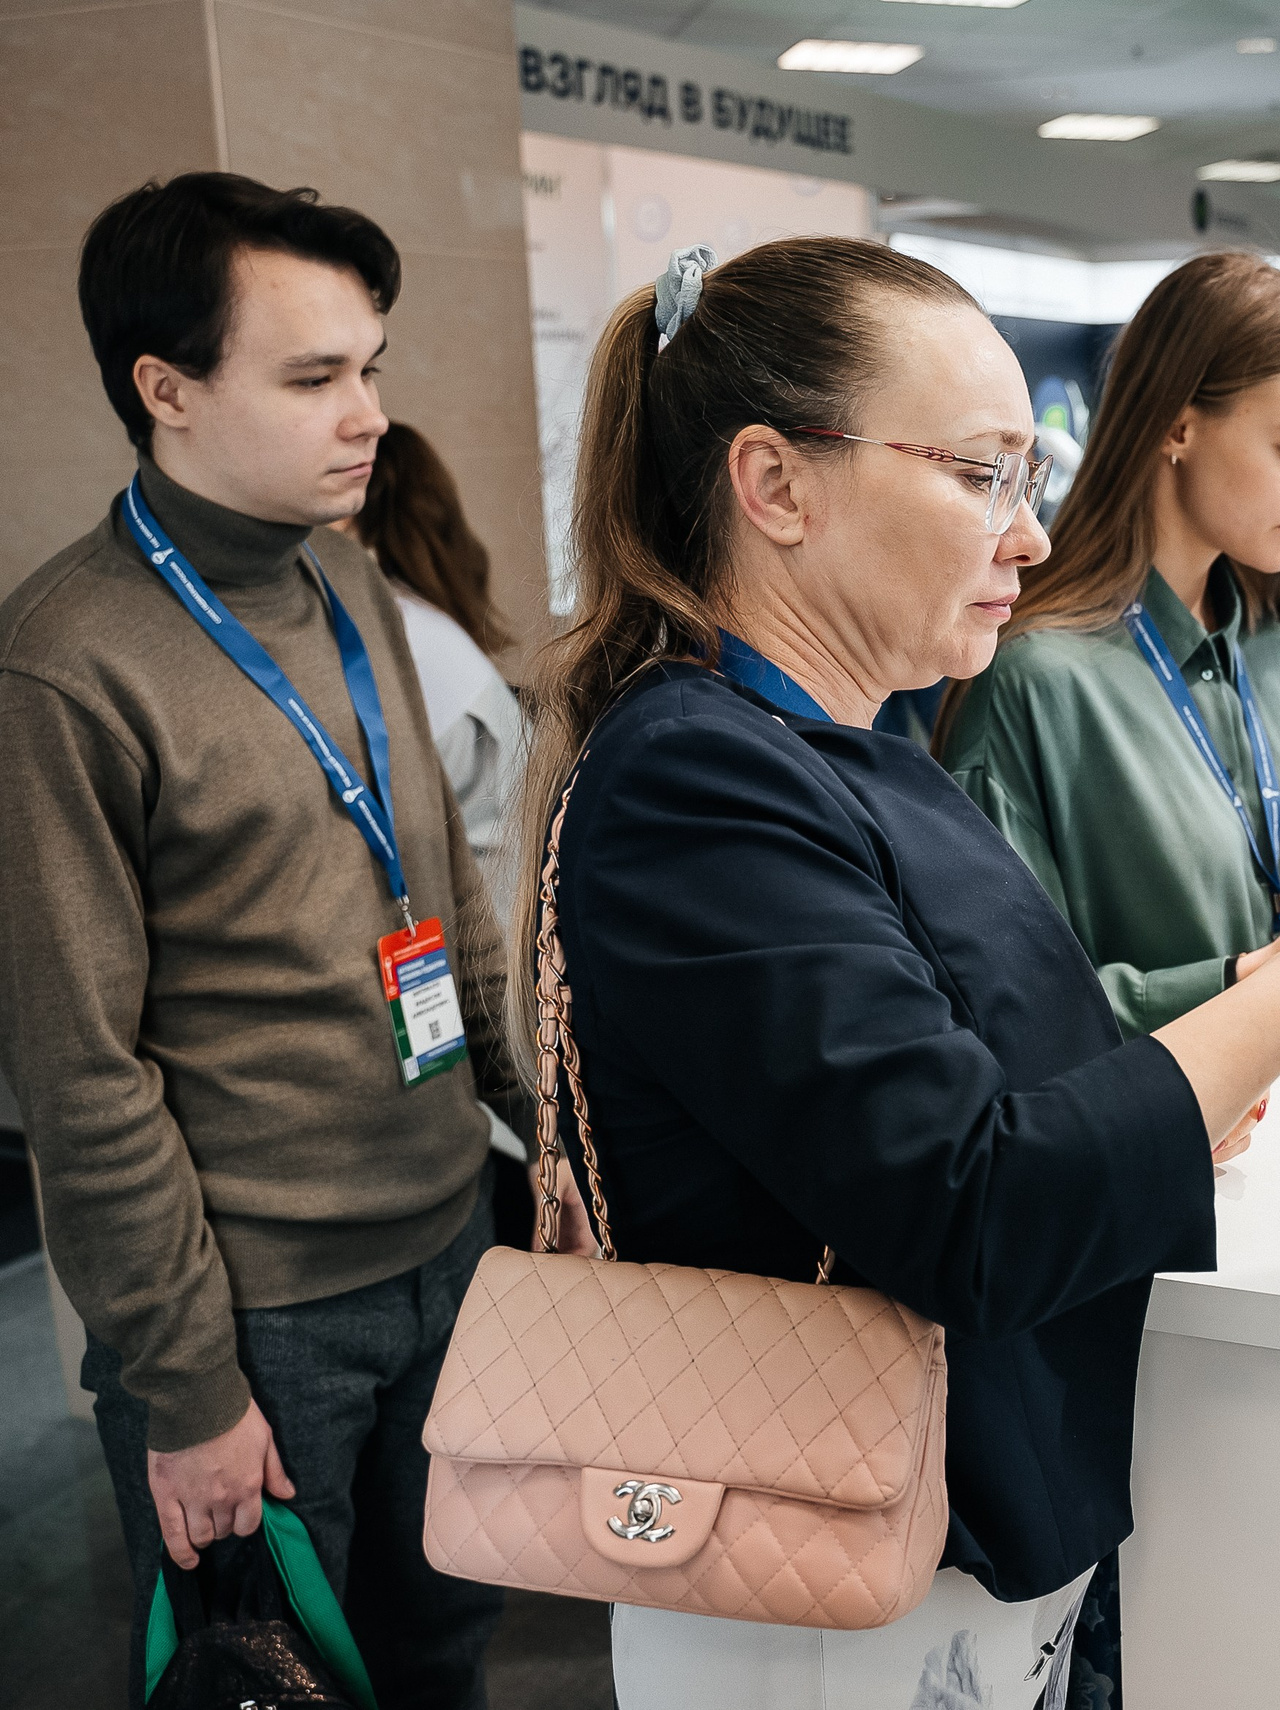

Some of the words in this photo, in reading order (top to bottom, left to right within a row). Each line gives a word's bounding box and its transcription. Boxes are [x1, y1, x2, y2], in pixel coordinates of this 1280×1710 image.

[520, 46, 671, 126] ВЗГЛЯД
[680, 81, 702, 124] В
[712, 87, 852, 153] БУДУЩЕЕ
